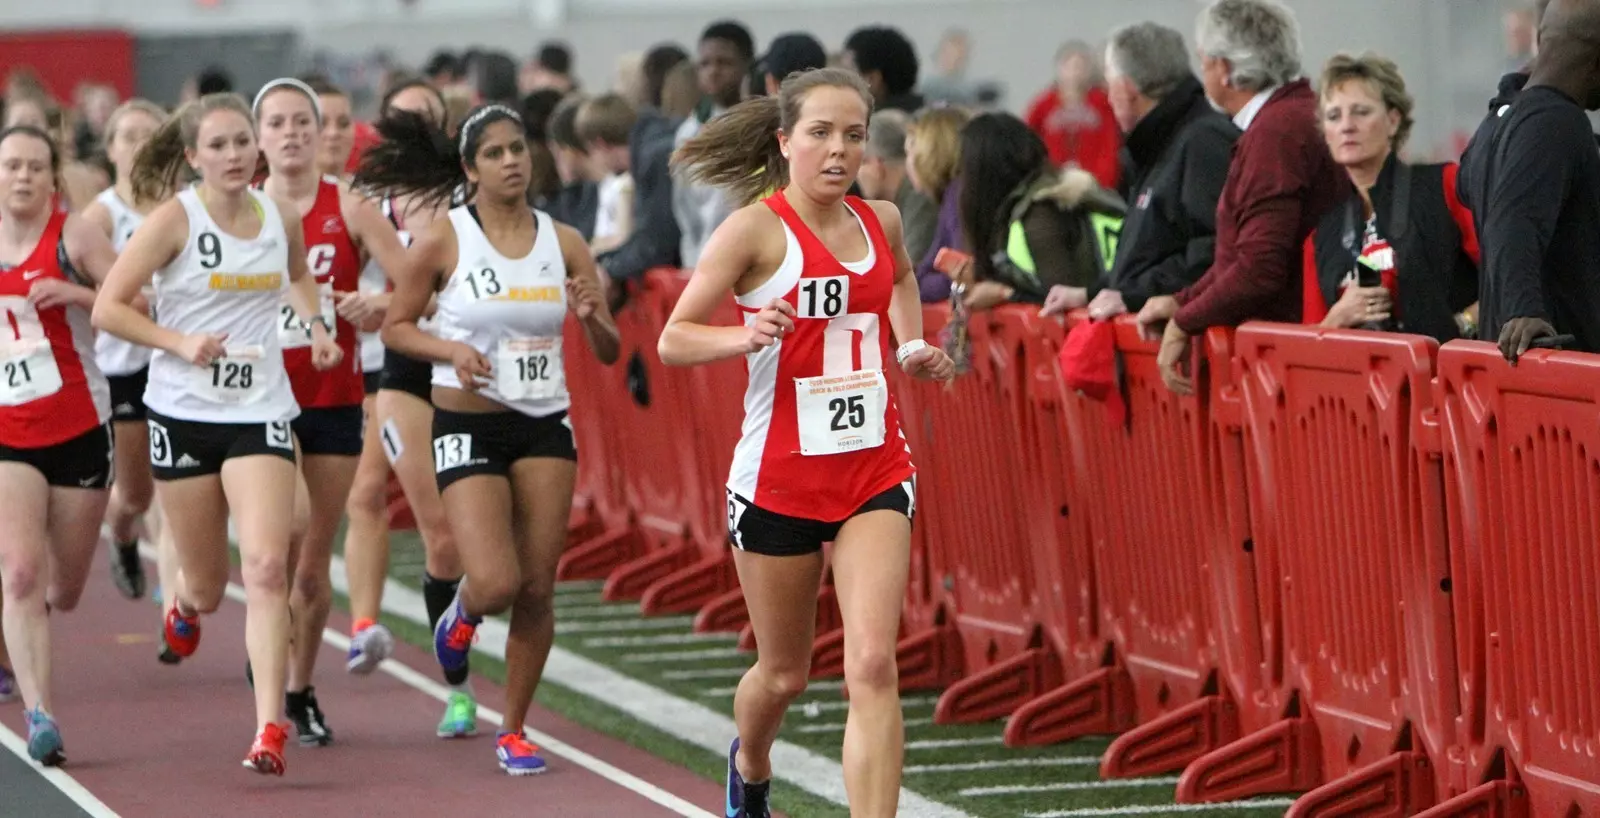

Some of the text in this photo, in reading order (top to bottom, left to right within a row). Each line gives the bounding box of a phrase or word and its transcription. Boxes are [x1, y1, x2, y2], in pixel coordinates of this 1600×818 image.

[197, 232, 222, 269] 9
[306, 244, 336, 276] C
[464, 267, 501, 299] 13
[802, 278, 842, 317] 18
[5, 360, 31, 387] 21
[210, 361, 253, 389] 129
[516, 354, 550, 381] 152
[828, 394, 866, 432] 25
[152, 426, 167, 461] 9
[437, 436, 463, 467] 13
